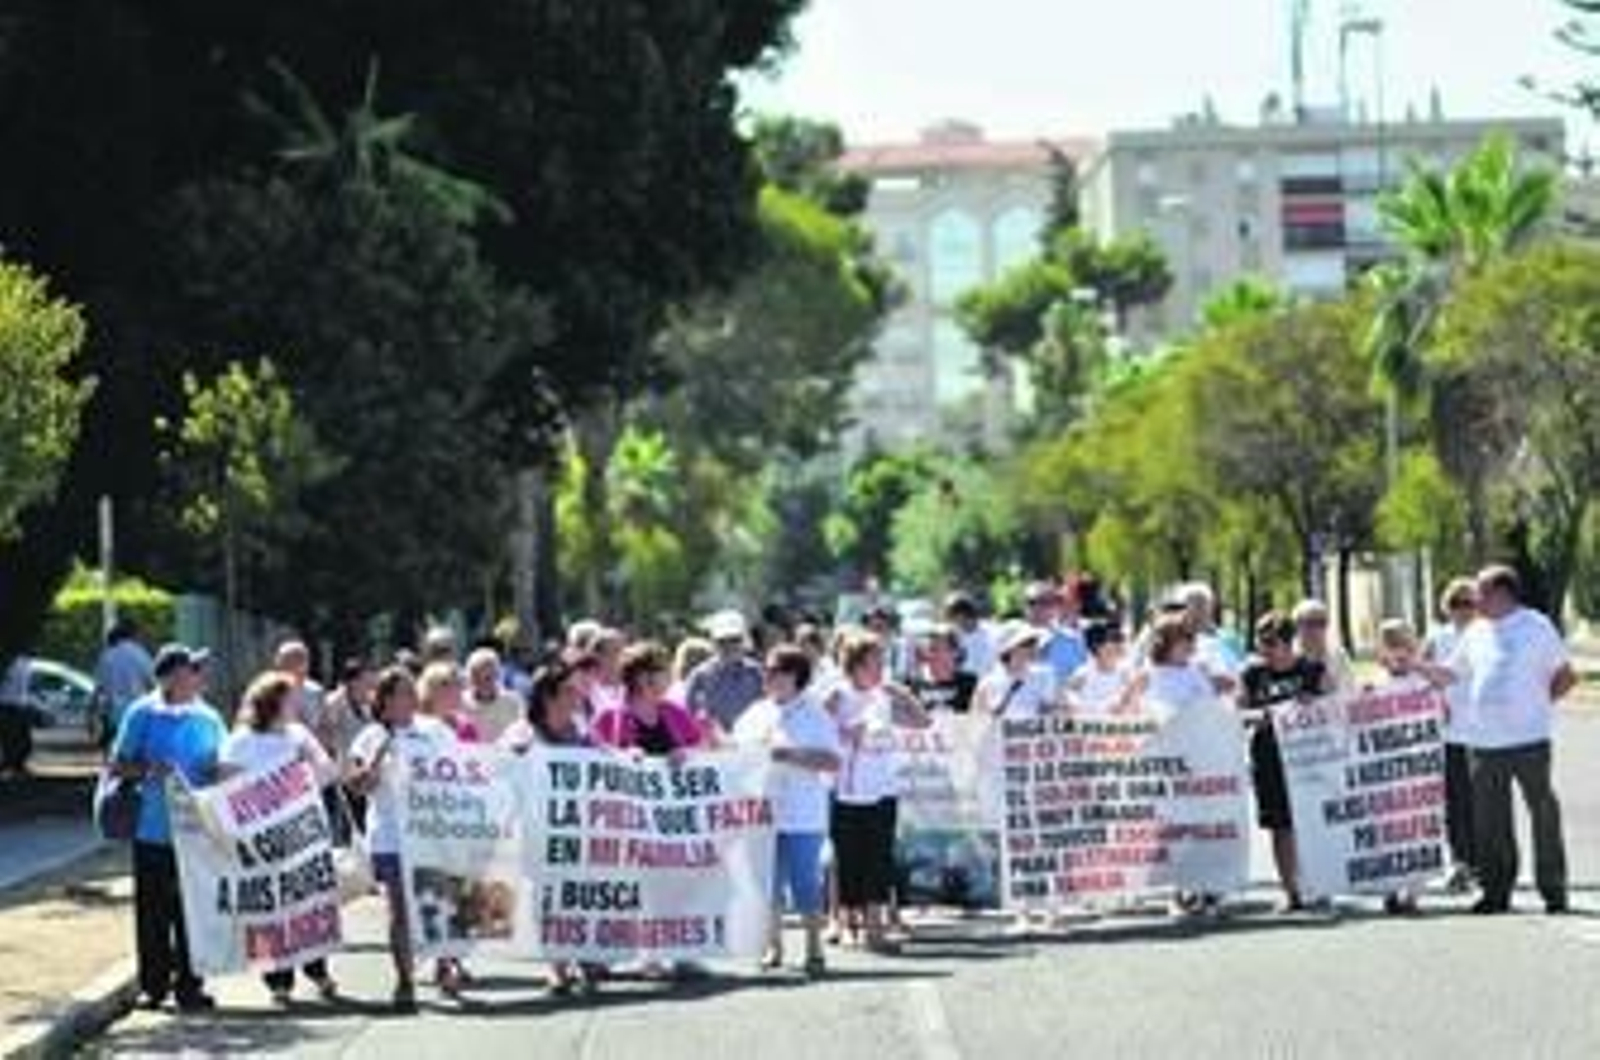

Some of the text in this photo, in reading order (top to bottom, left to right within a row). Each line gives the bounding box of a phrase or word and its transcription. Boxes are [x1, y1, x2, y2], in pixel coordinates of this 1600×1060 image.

[547, 761, 581, 791] TU
[671, 765, 721, 797] SER
[547, 799, 581, 829] LA
[653, 804, 700, 835] QUE
[706, 798, 773, 830] FALTA
[546, 837, 581, 865] EN
[589, 836, 620, 866] MI
[561, 879, 643, 912] BUSCA
[541, 915, 587, 947] TUS
